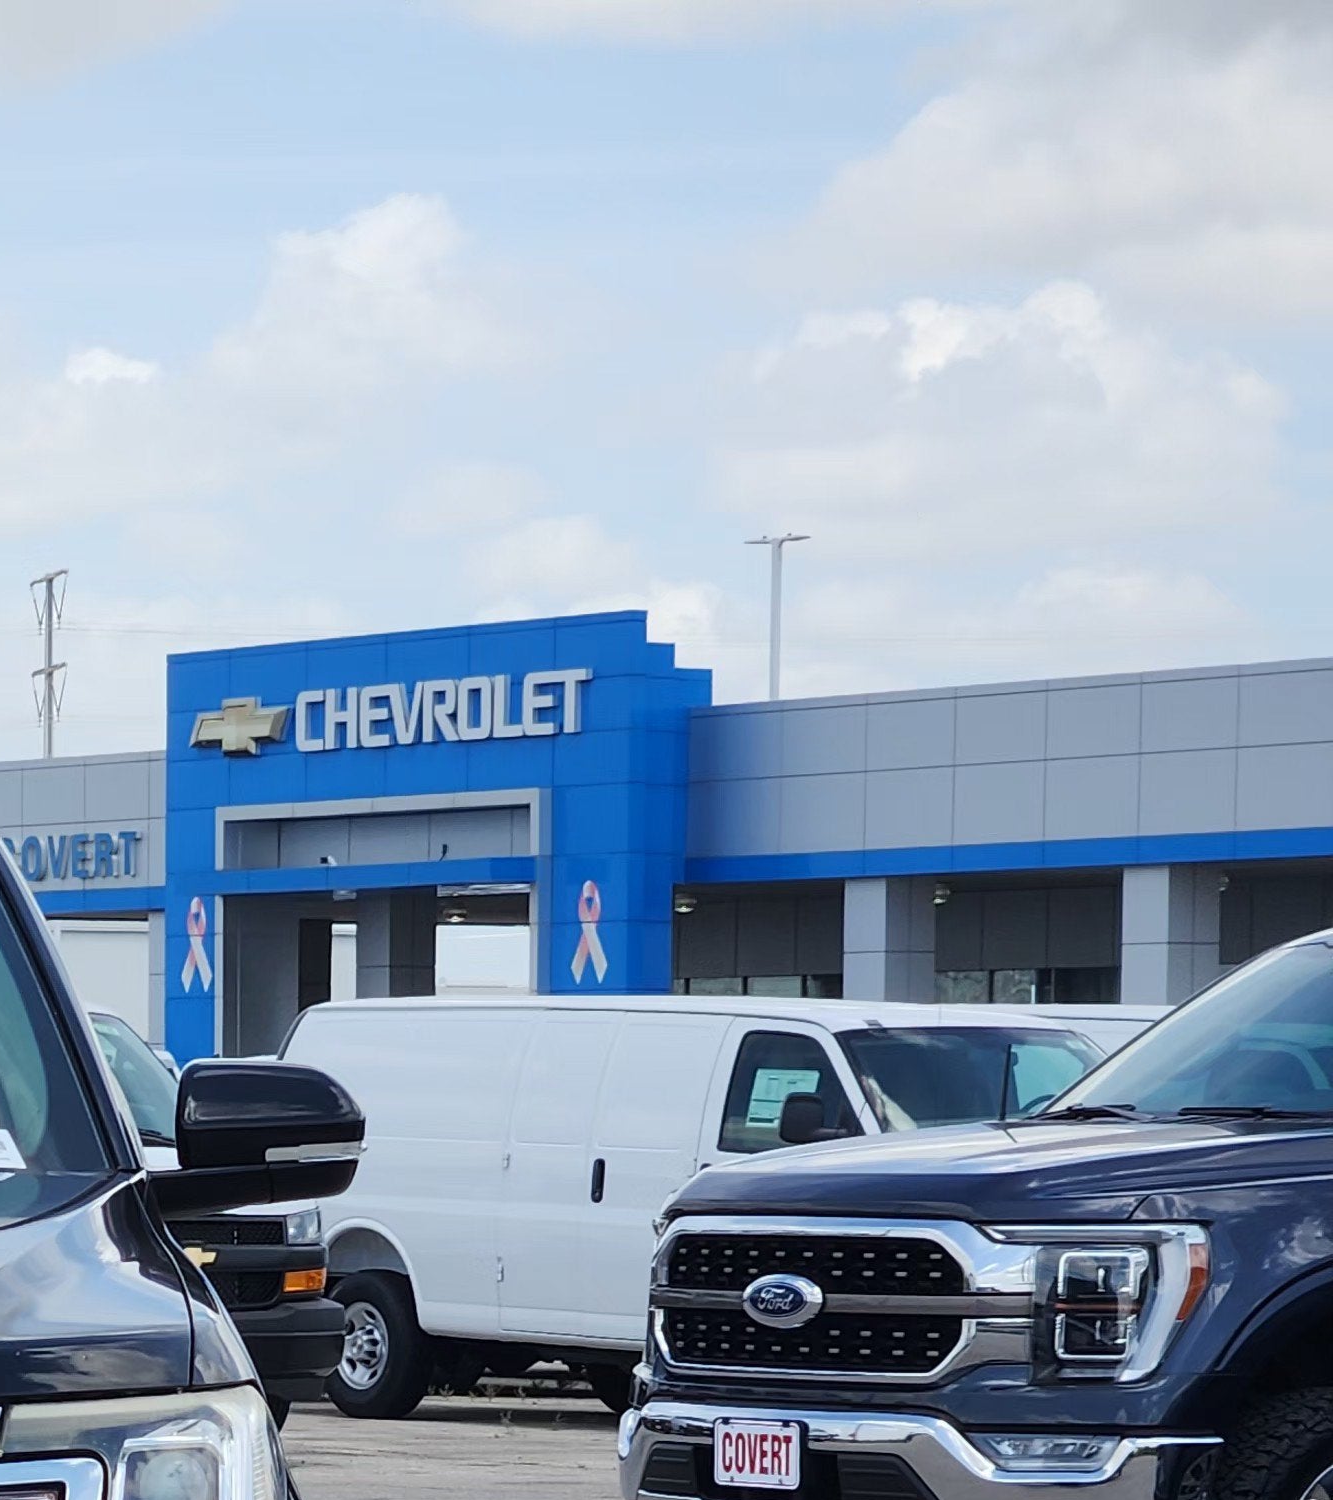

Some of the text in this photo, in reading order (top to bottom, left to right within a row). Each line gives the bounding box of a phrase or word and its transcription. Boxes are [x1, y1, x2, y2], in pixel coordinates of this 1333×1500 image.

[295, 668, 590, 753] CHEVROLET
[757, 1287, 794, 1311] Ford
[722, 1431, 793, 1477] COVERT
